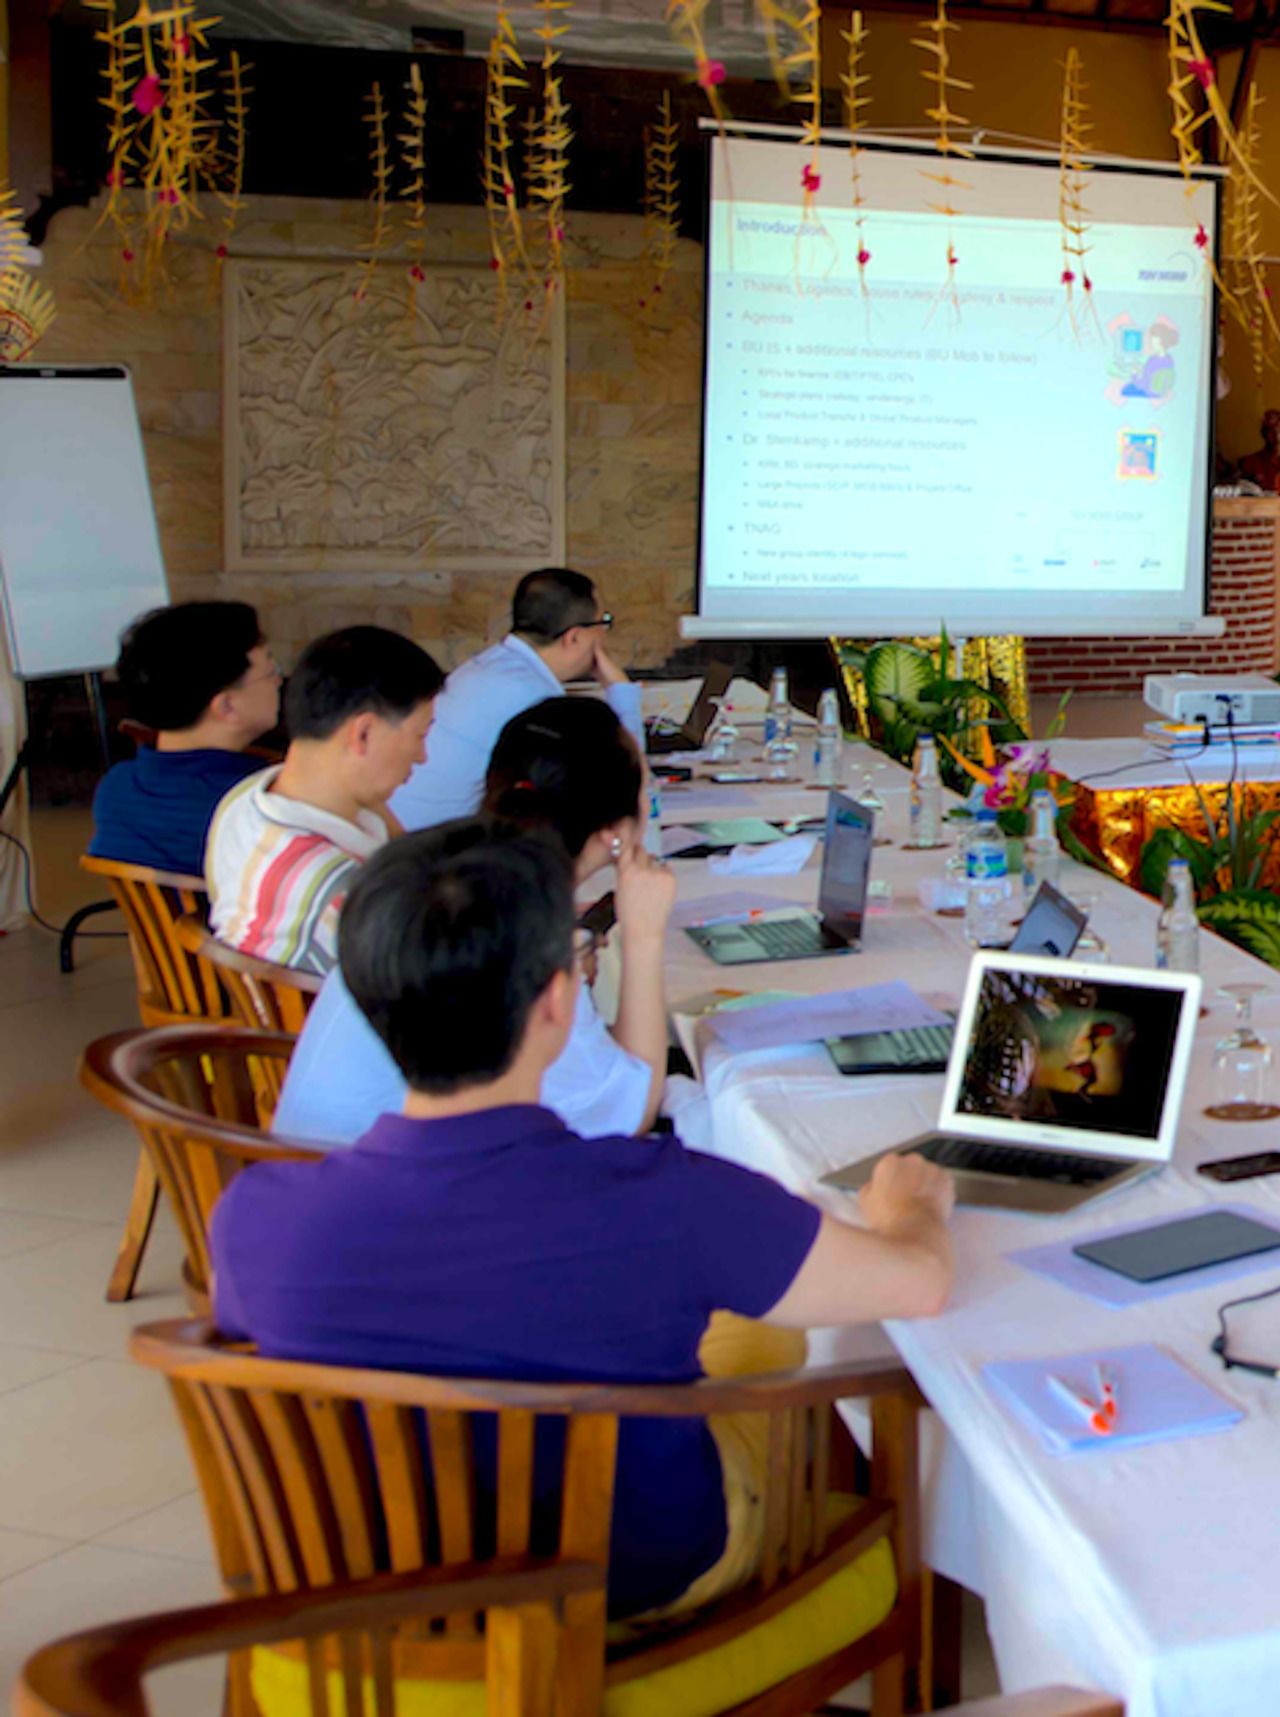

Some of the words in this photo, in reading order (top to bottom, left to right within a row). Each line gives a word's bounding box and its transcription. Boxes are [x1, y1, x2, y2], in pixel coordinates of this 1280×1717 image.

[736, 217, 828, 236] Introduction
[741, 309, 794, 325] Agenda
[796, 343, 857, 358] additional
[861, 347, 922, 360] resources
[843, 437, 905, 451] additional
[907, 440, 967, 452] resources
[743, 569, 771, 582] Next
[812, 569, 860, 582] location
